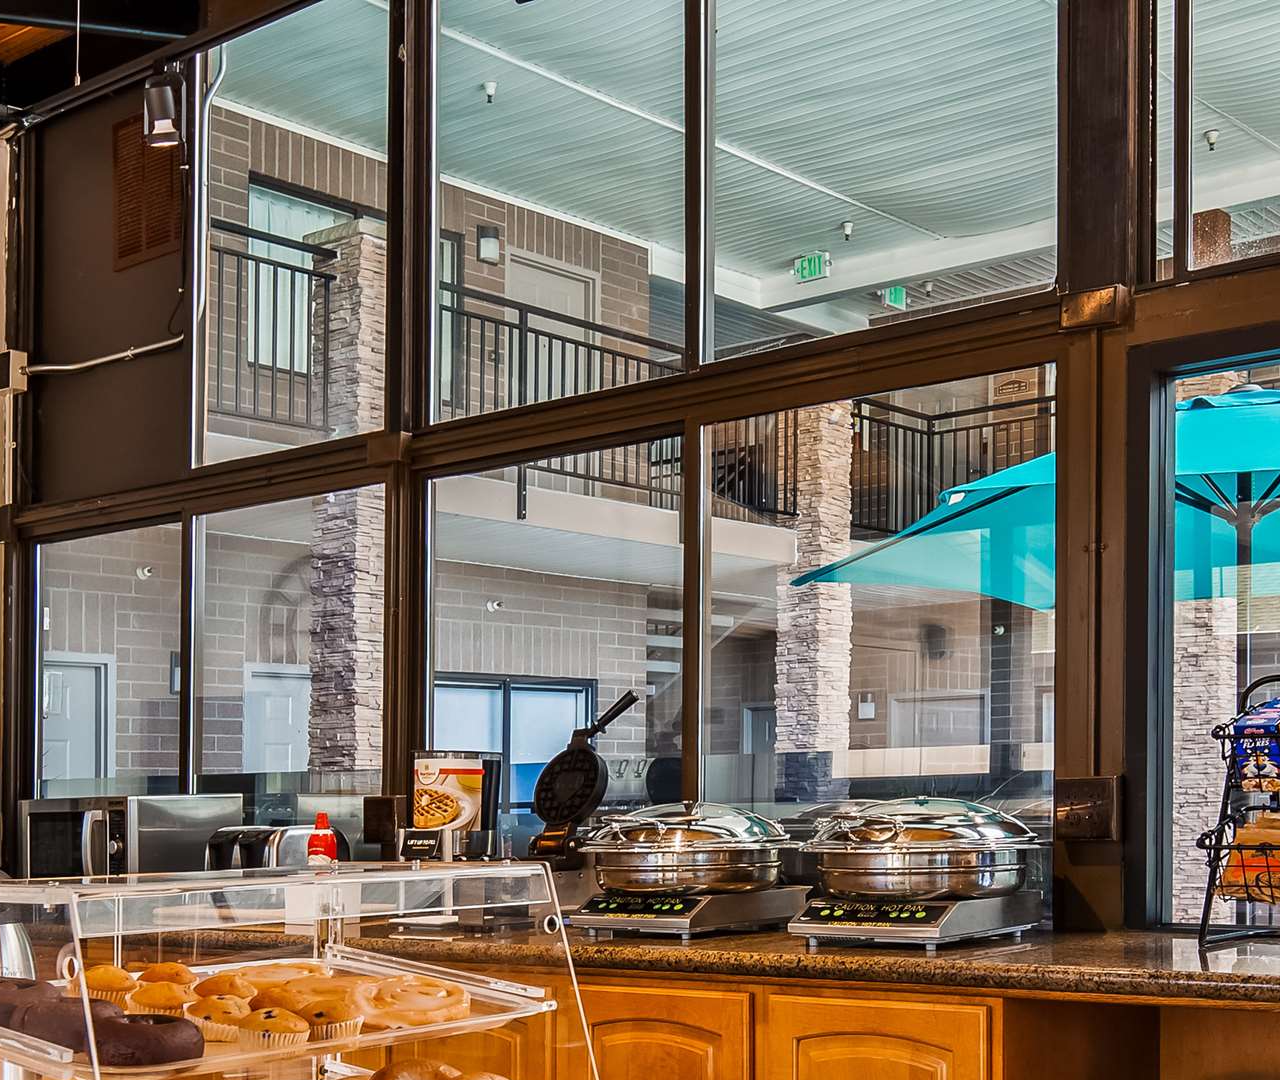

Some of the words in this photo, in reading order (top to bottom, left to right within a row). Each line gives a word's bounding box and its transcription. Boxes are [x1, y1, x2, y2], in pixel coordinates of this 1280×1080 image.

[800, 255, 823, 280] EXIT
[834, 903, 875, 911] CAUTION
[881, 904, 902, 912] HOT
[902, 904, 925, 912] PAN
